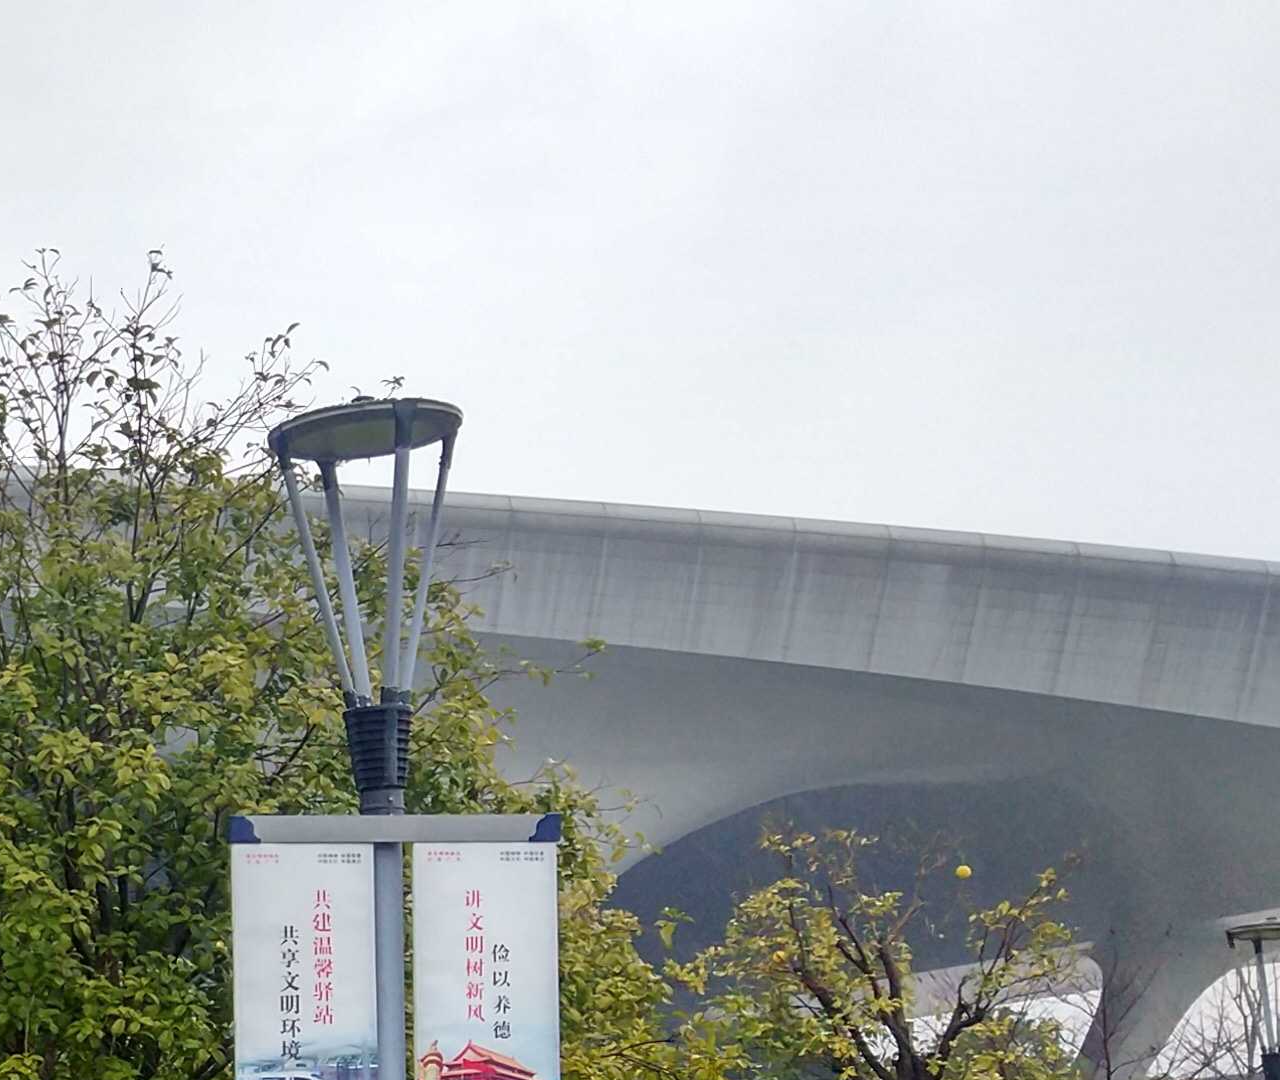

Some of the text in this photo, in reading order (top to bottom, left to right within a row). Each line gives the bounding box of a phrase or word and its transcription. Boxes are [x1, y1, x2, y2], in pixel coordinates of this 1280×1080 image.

[279, 925, 302, 1061] 共享文明环境
[312, 888, 334, 1025] 共建温馨驿站
[464, 888, 485, 1022] 讲文明树新风
[492, 943, 512, 1040] 俭以养德
